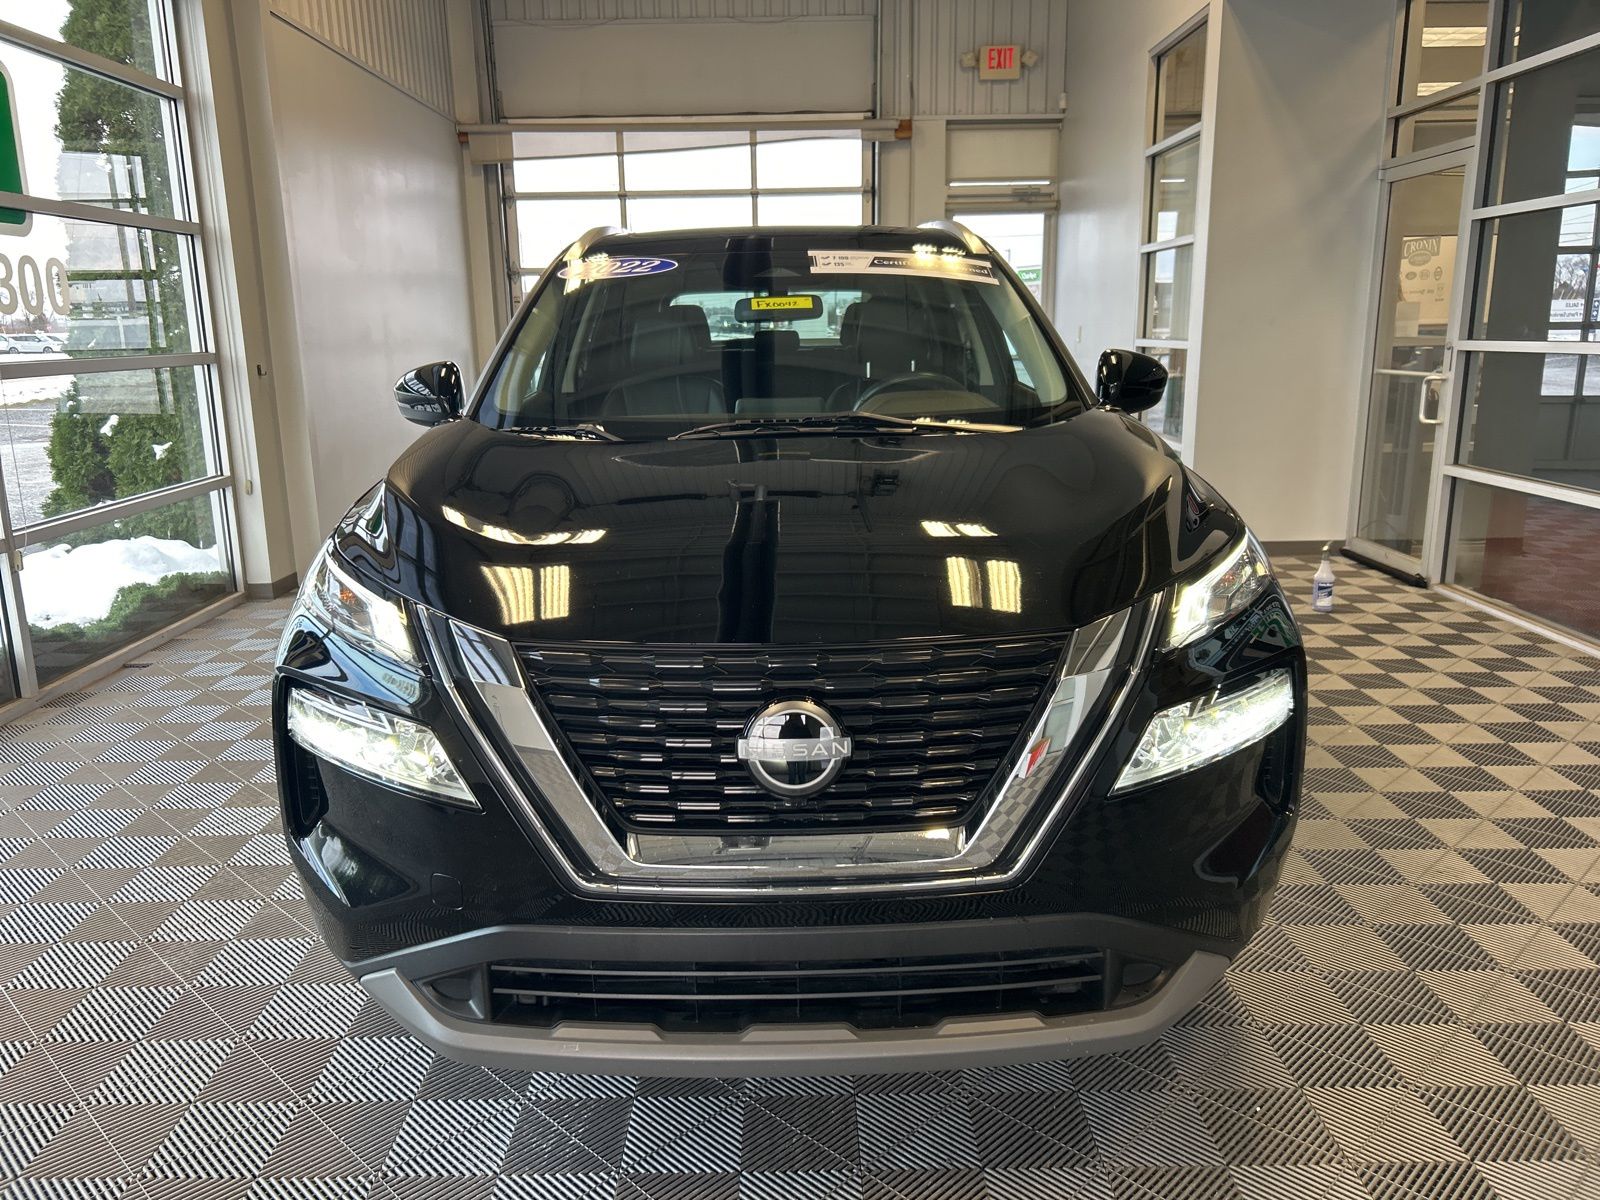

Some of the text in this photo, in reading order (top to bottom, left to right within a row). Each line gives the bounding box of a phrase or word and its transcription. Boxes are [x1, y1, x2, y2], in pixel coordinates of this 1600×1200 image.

[988, 47, 1014, 70] EXIT
[579, 260, 662, 274] 022
[742, 740, 848, 757] NSSAN
